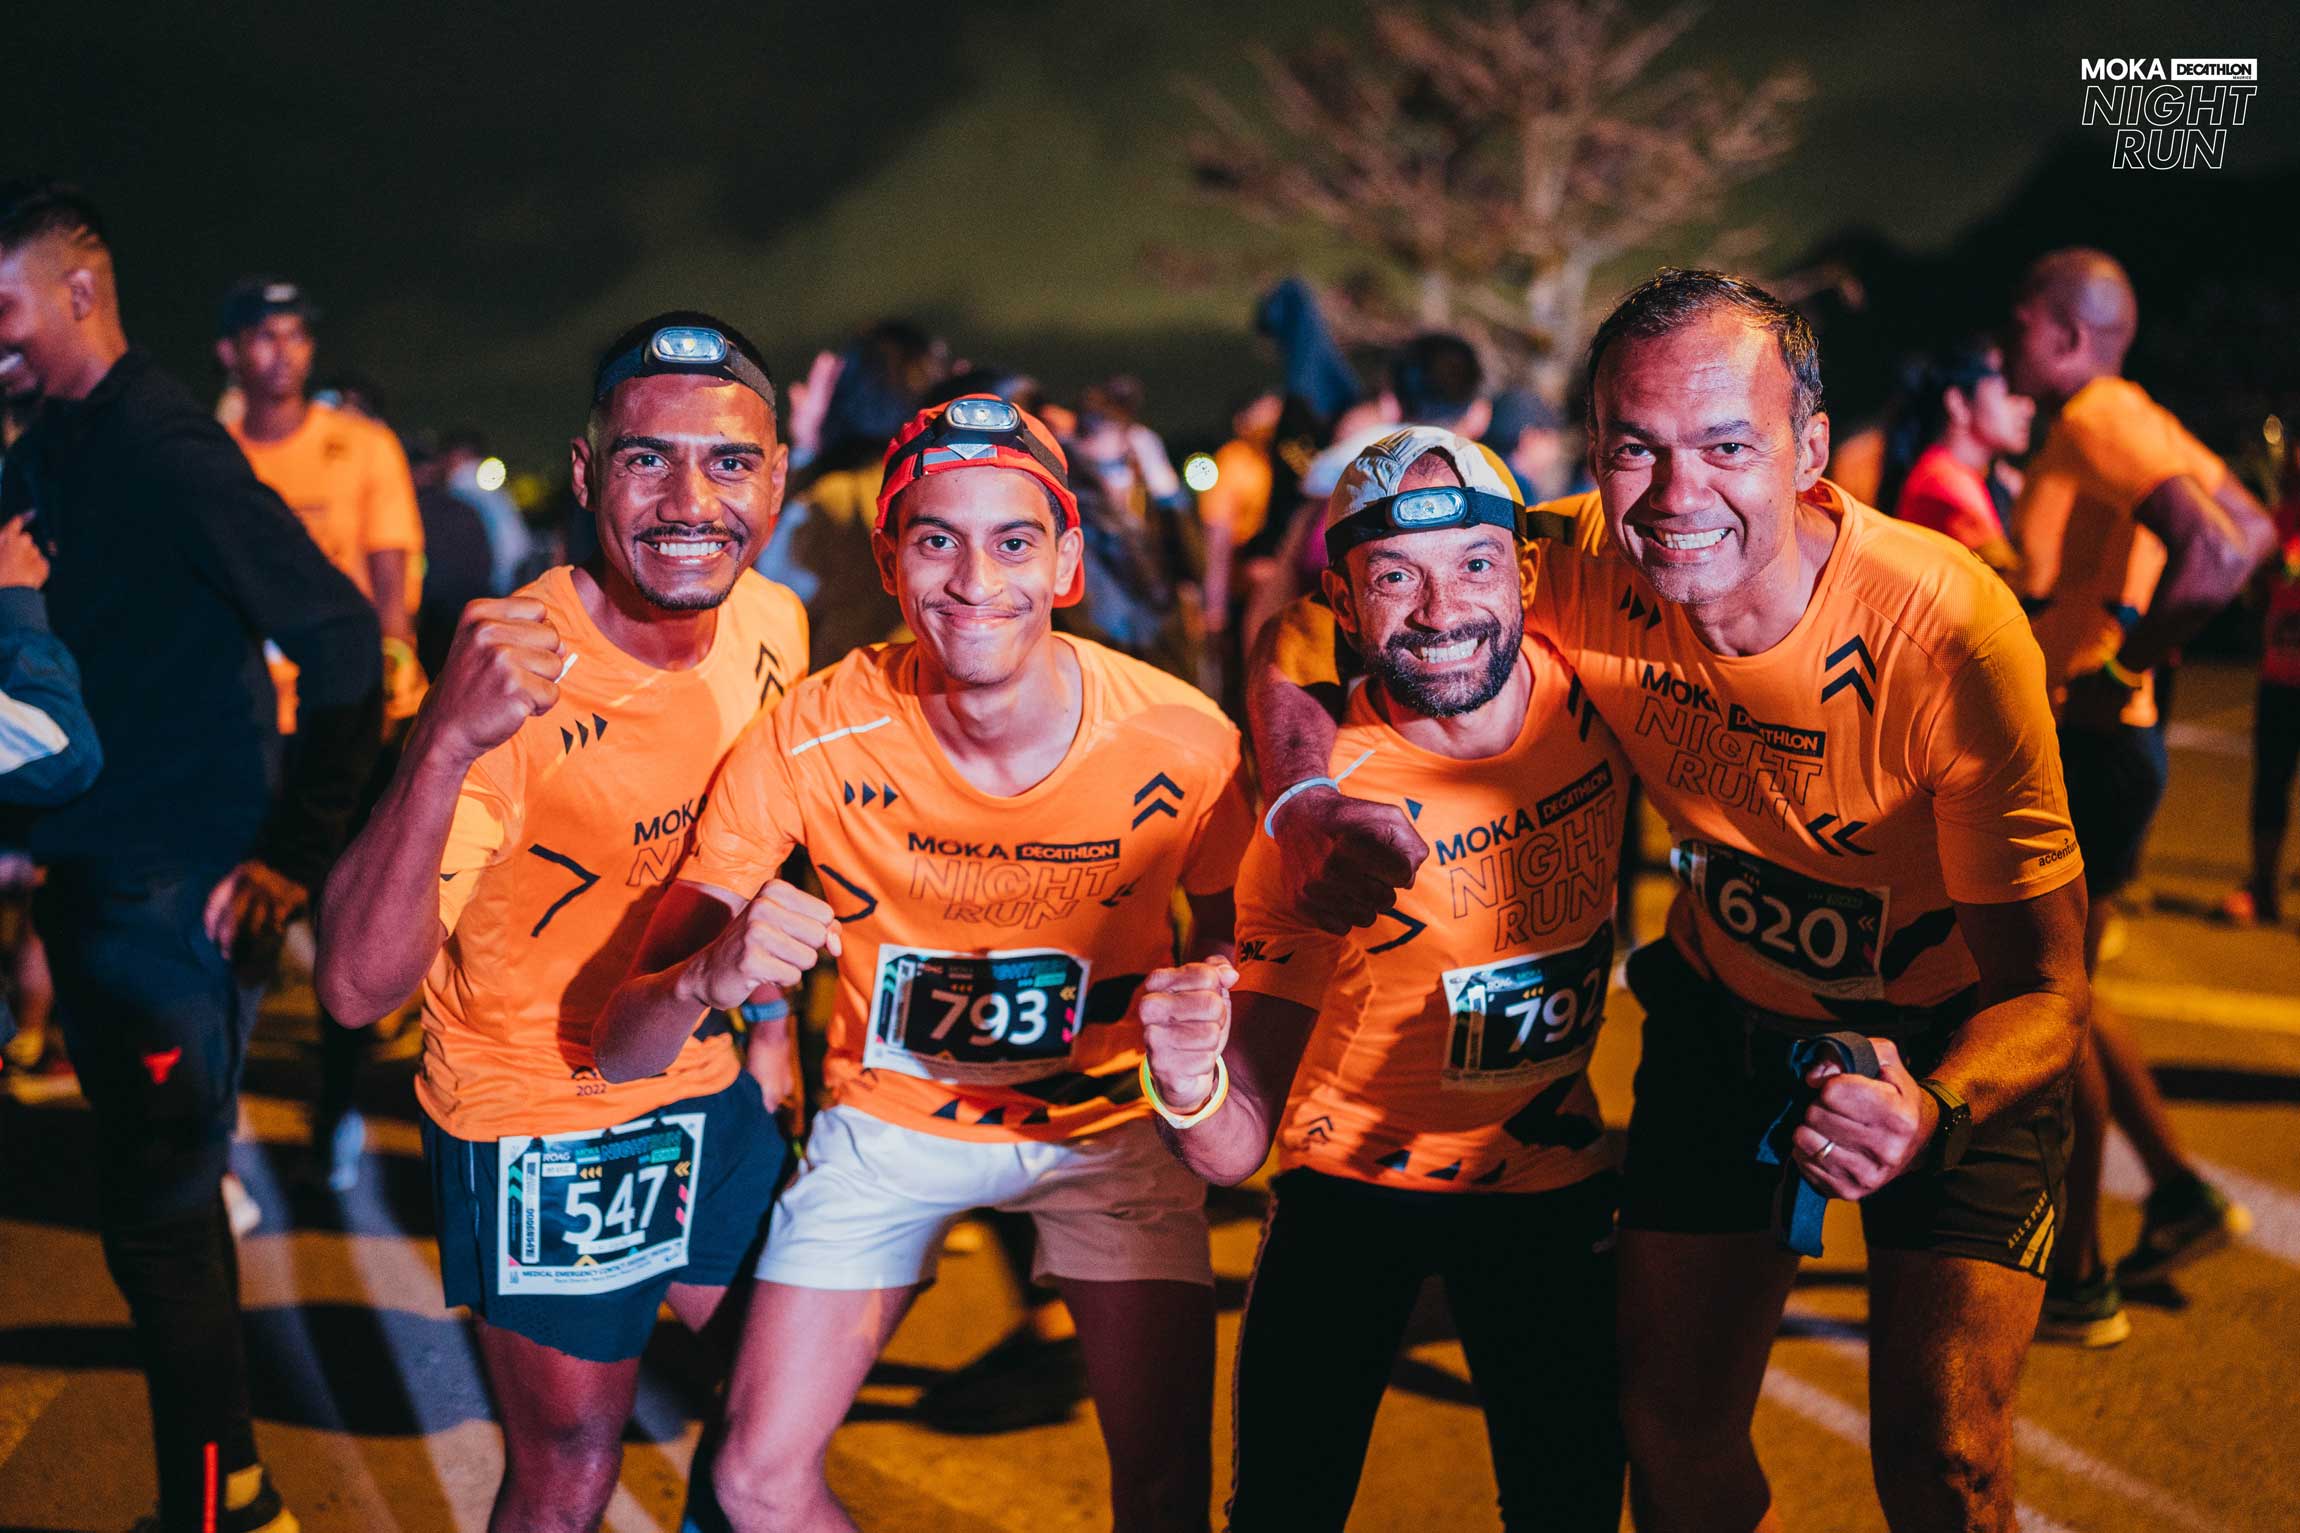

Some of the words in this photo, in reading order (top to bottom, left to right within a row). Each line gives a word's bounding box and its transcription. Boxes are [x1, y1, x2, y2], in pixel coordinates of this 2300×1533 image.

[634, 794, 708, 846] MOK
[908, 832, 1009, 860] MOKA
[1022, 842, 1115, 860] DECATHLON
[1435, 808, 1535, 865] MOKA
[909, 856, 1120, 904] NIGHT
[1450, 791, 1617, 919] NIGHT
[944, 899, 1080, 930] RUN
[1494, 858, 1606, 952] RUN
[1719, 878, 1848, 968] 620
[930, 988, 1048, 1046] 793
[576, 1083, 607, 1097] 2022
[562, 1164, 668, 1246] 547
